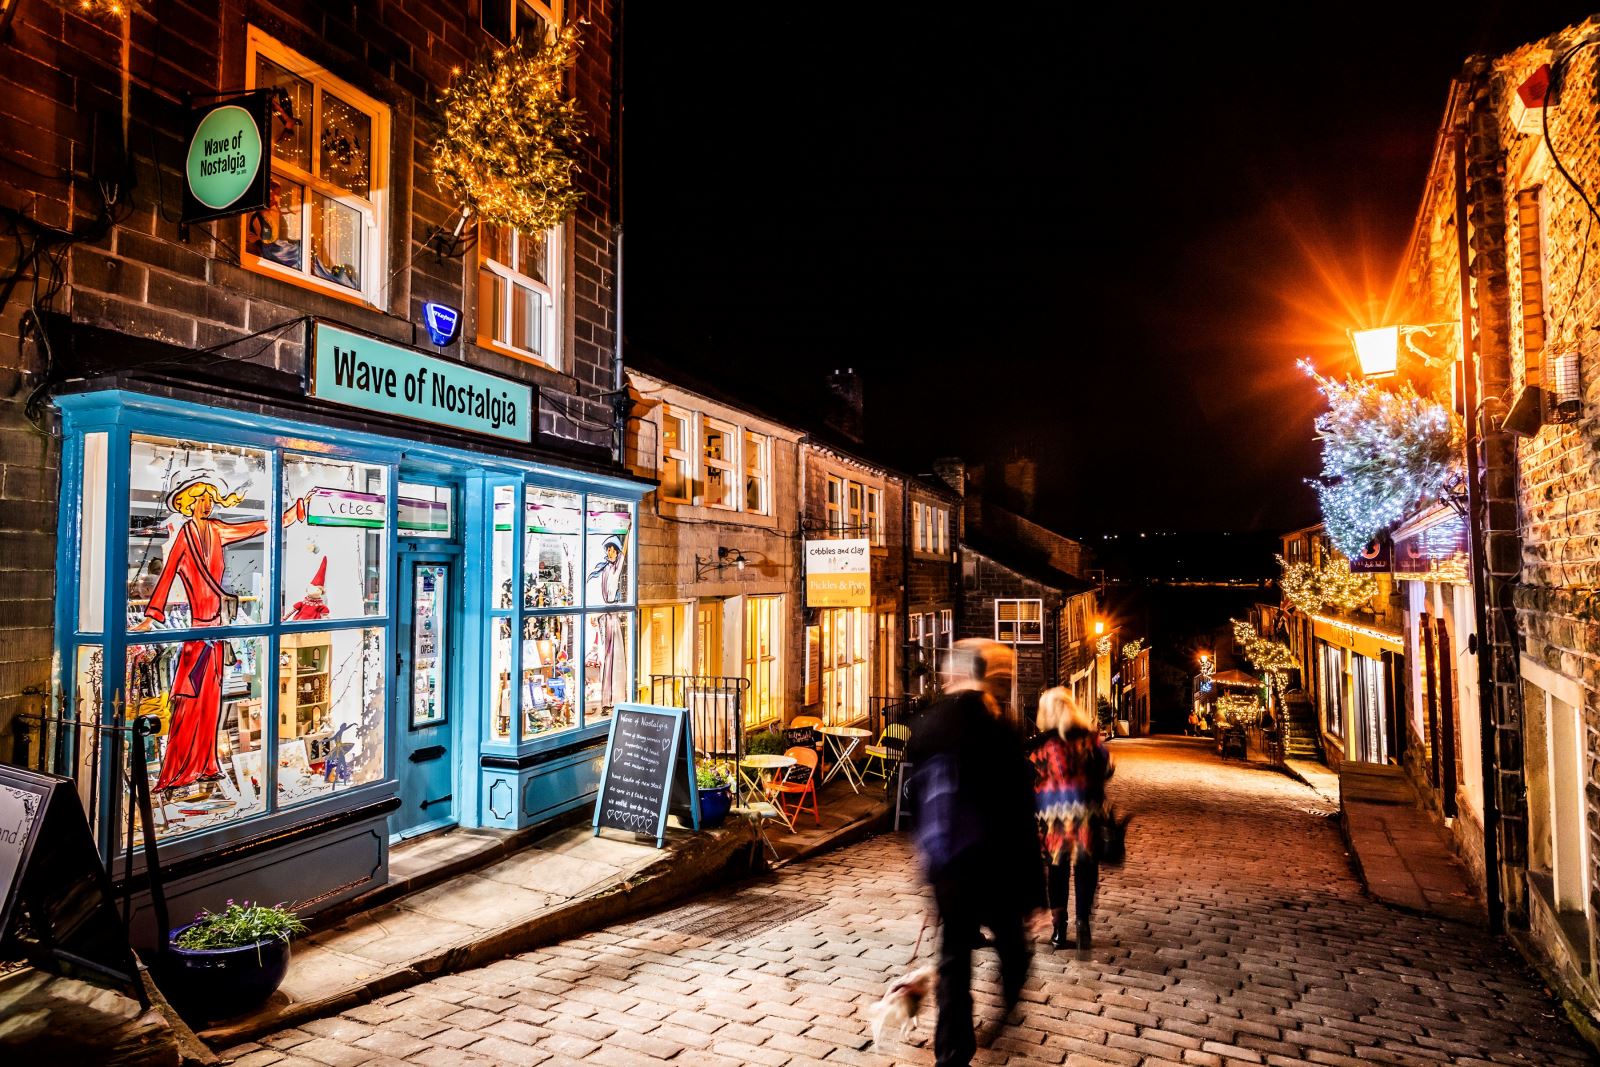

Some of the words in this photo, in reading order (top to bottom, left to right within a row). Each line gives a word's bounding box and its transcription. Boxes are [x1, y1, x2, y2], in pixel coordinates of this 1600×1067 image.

[204, 138, 230, 157] Wave
[231, 130, 243, 150] of
[200, 152, 246, 177] Nostalgia
[333, 346, 397, 398] Wave
[404, 367, 428, 404] of
[432, 372, 516, 429] Nostalgia
